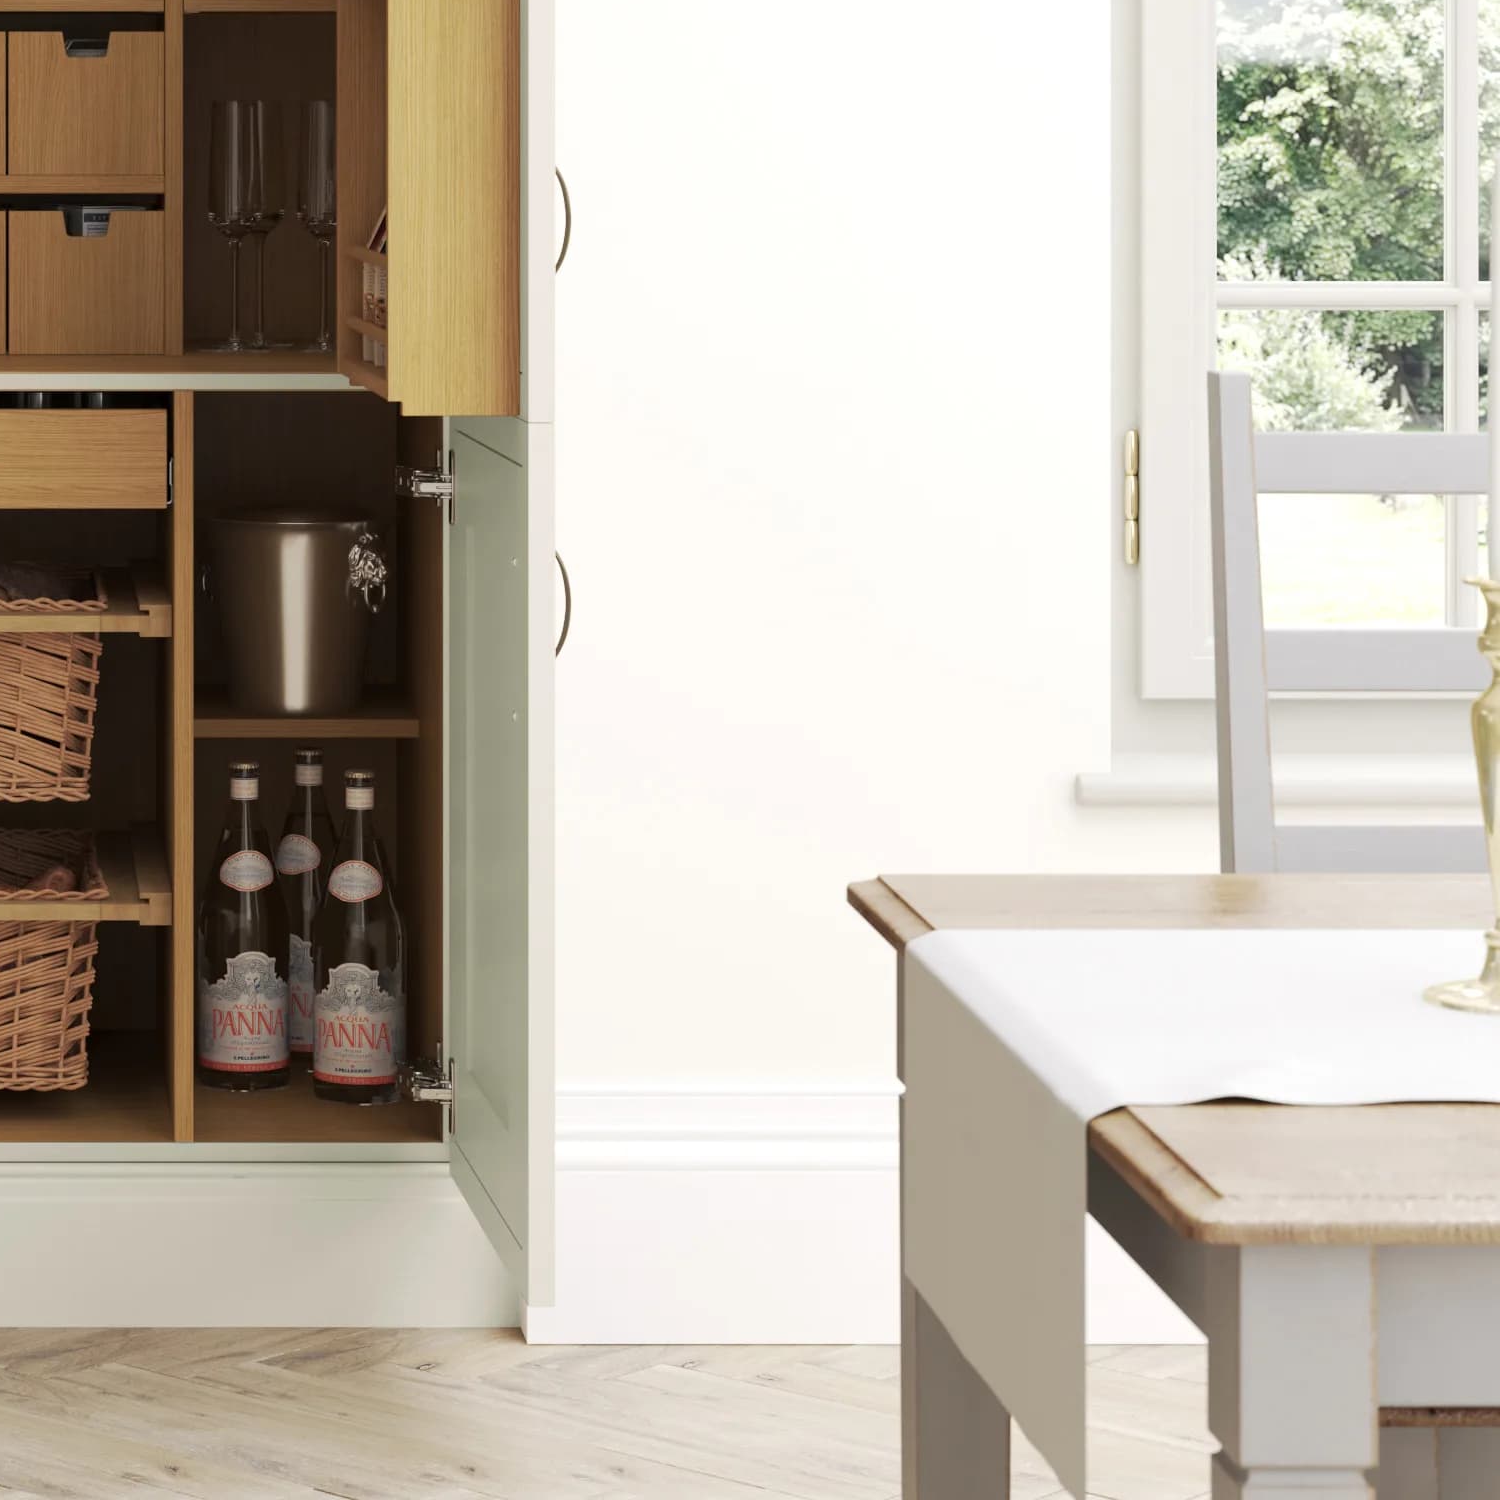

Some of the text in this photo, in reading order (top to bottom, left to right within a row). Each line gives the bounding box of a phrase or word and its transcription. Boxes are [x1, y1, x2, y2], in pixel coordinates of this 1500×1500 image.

[233, 1003, 268, 1011] ACQUA
[212, 1008, 284, 1041] PANNA
[333, 1014, 370, 1022] ACQUA
[317, 1017, 391, 1053] PANNA
